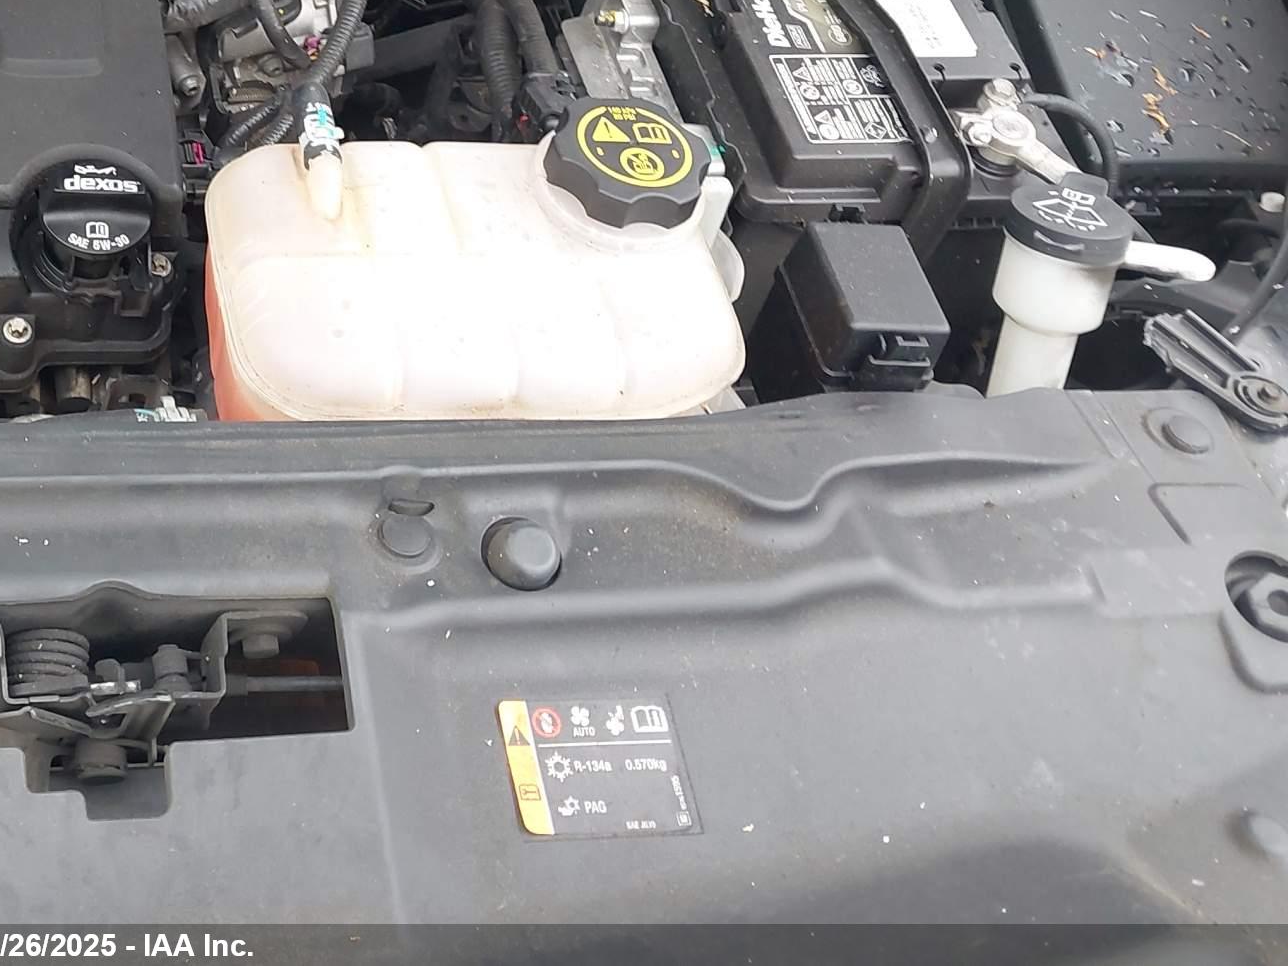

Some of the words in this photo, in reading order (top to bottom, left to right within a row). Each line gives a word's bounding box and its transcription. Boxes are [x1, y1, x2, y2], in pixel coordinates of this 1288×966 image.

[63, 174, 139, 193] dexos
[67, 232, 90, 250] SAE
[573, 726, 596, 738] AUTO
[573, 759, 613, 773] R-134a
